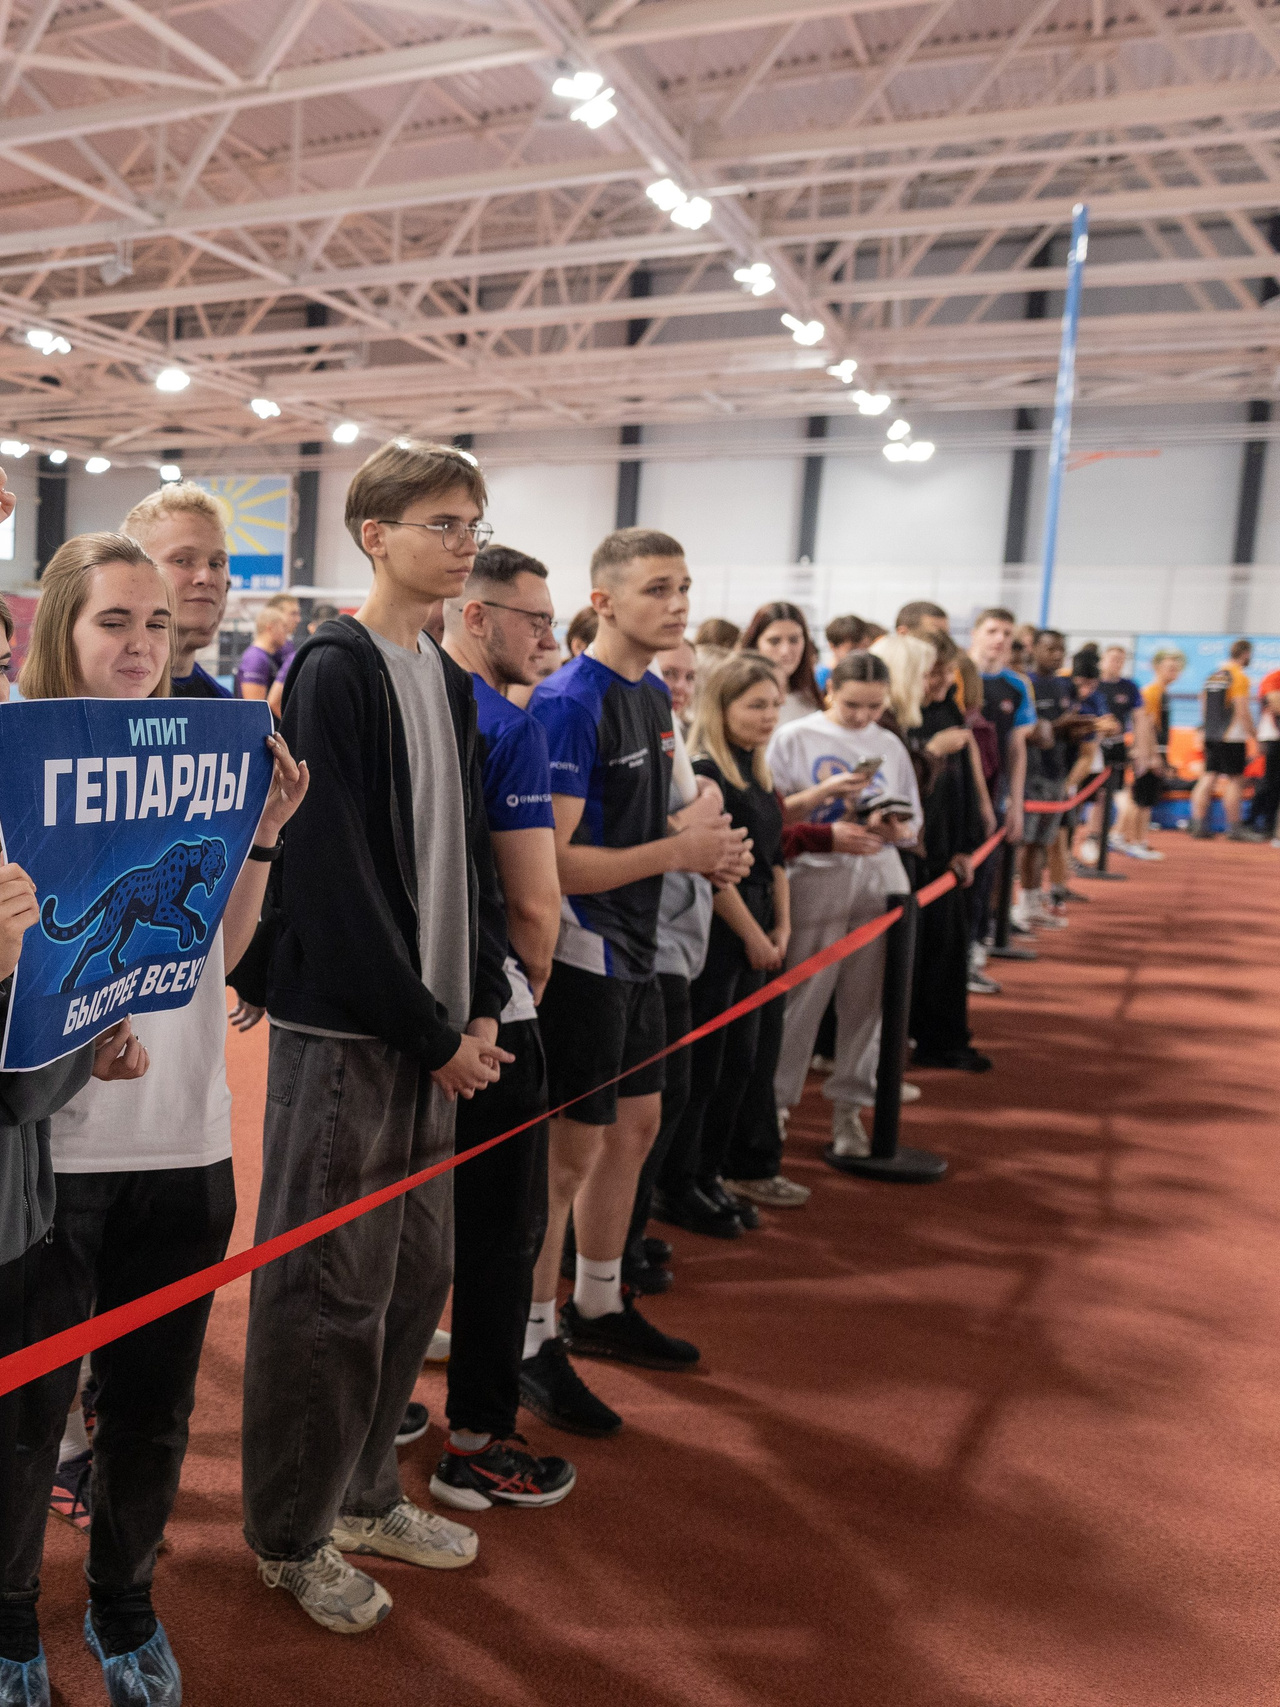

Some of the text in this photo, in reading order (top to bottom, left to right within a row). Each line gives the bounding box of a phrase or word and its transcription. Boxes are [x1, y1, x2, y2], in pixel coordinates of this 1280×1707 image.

[128, 717, 189, 747] ИПИТ
[43, 752, 251, 827] ГЕПАРДЫ
[62, 955, 207, 1036] БЫСТРЕЕ ВСЕХ!
